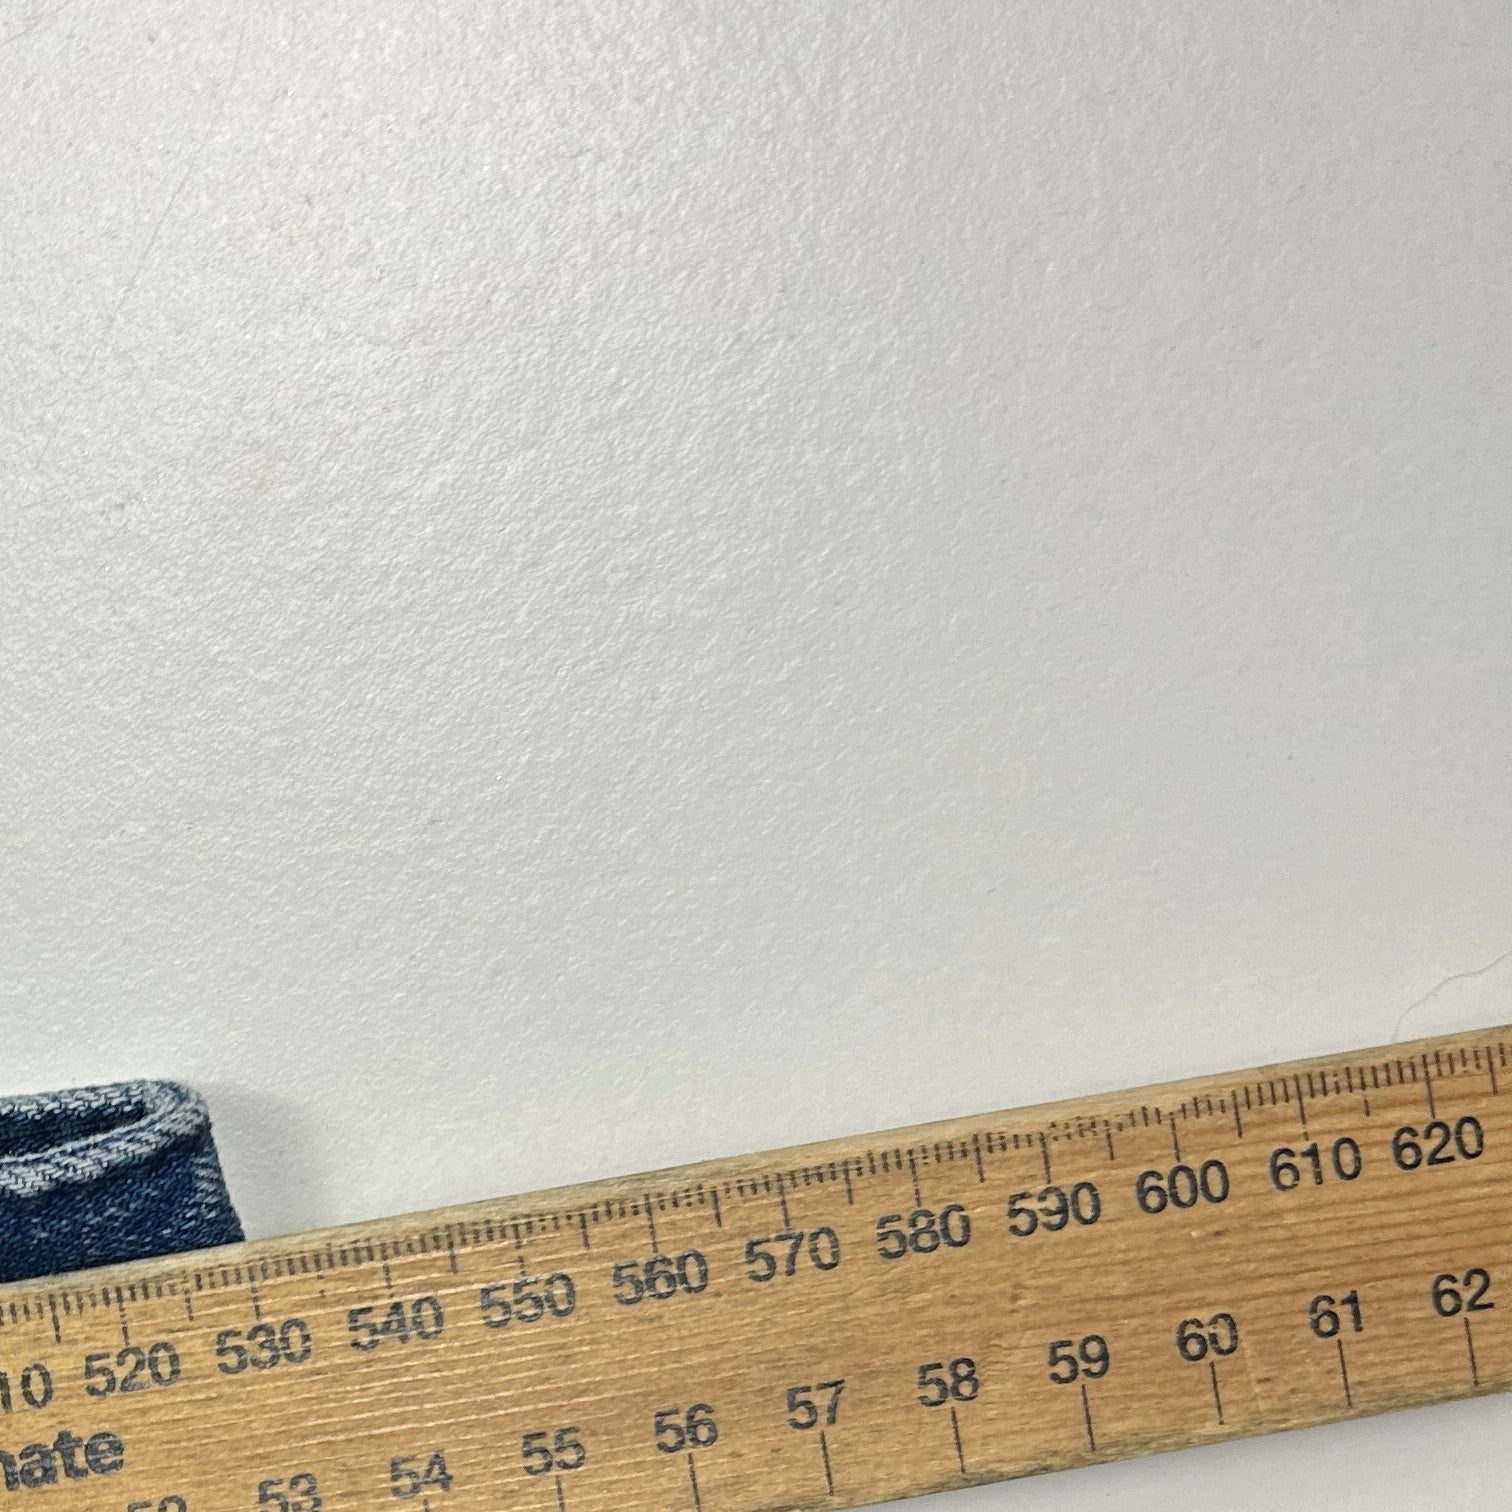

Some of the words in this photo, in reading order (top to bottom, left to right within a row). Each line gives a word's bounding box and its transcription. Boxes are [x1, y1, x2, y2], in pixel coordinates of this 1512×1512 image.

[85, 1341, 181, 1397] 520
[216, 1318, 312, 1374] 530
[348, 1296, 444, 1352] 540
[480, 1272, 577, 1328] 550
[612, 1248, 709, 1305] 560
[745, 1227, 840, 1282] 570
[876, 1204, 972, 1259] 580
[1007, 1182, 1101, 1237] 590
[1136, 1159, 1230, 1214] 600
[1270, 1137, 1362, 1192] 610
[1392, 1116, 1484, 1170] 620
[390, 1449, 453, 1499] 54
[521, 1426, 586, 1476] 55
[654, 1403, 718, 1453] 56
[787, 1379, 846, 1430] 57
[917, 1358, 980, 1407] 58
[1048, 1334, 1110, 1384] 59
[1176, 1312, 1239, 1362] 60
[1308, 1290, 1364, 1339] 61
[1431, 1268, 1494, 1318] 62
